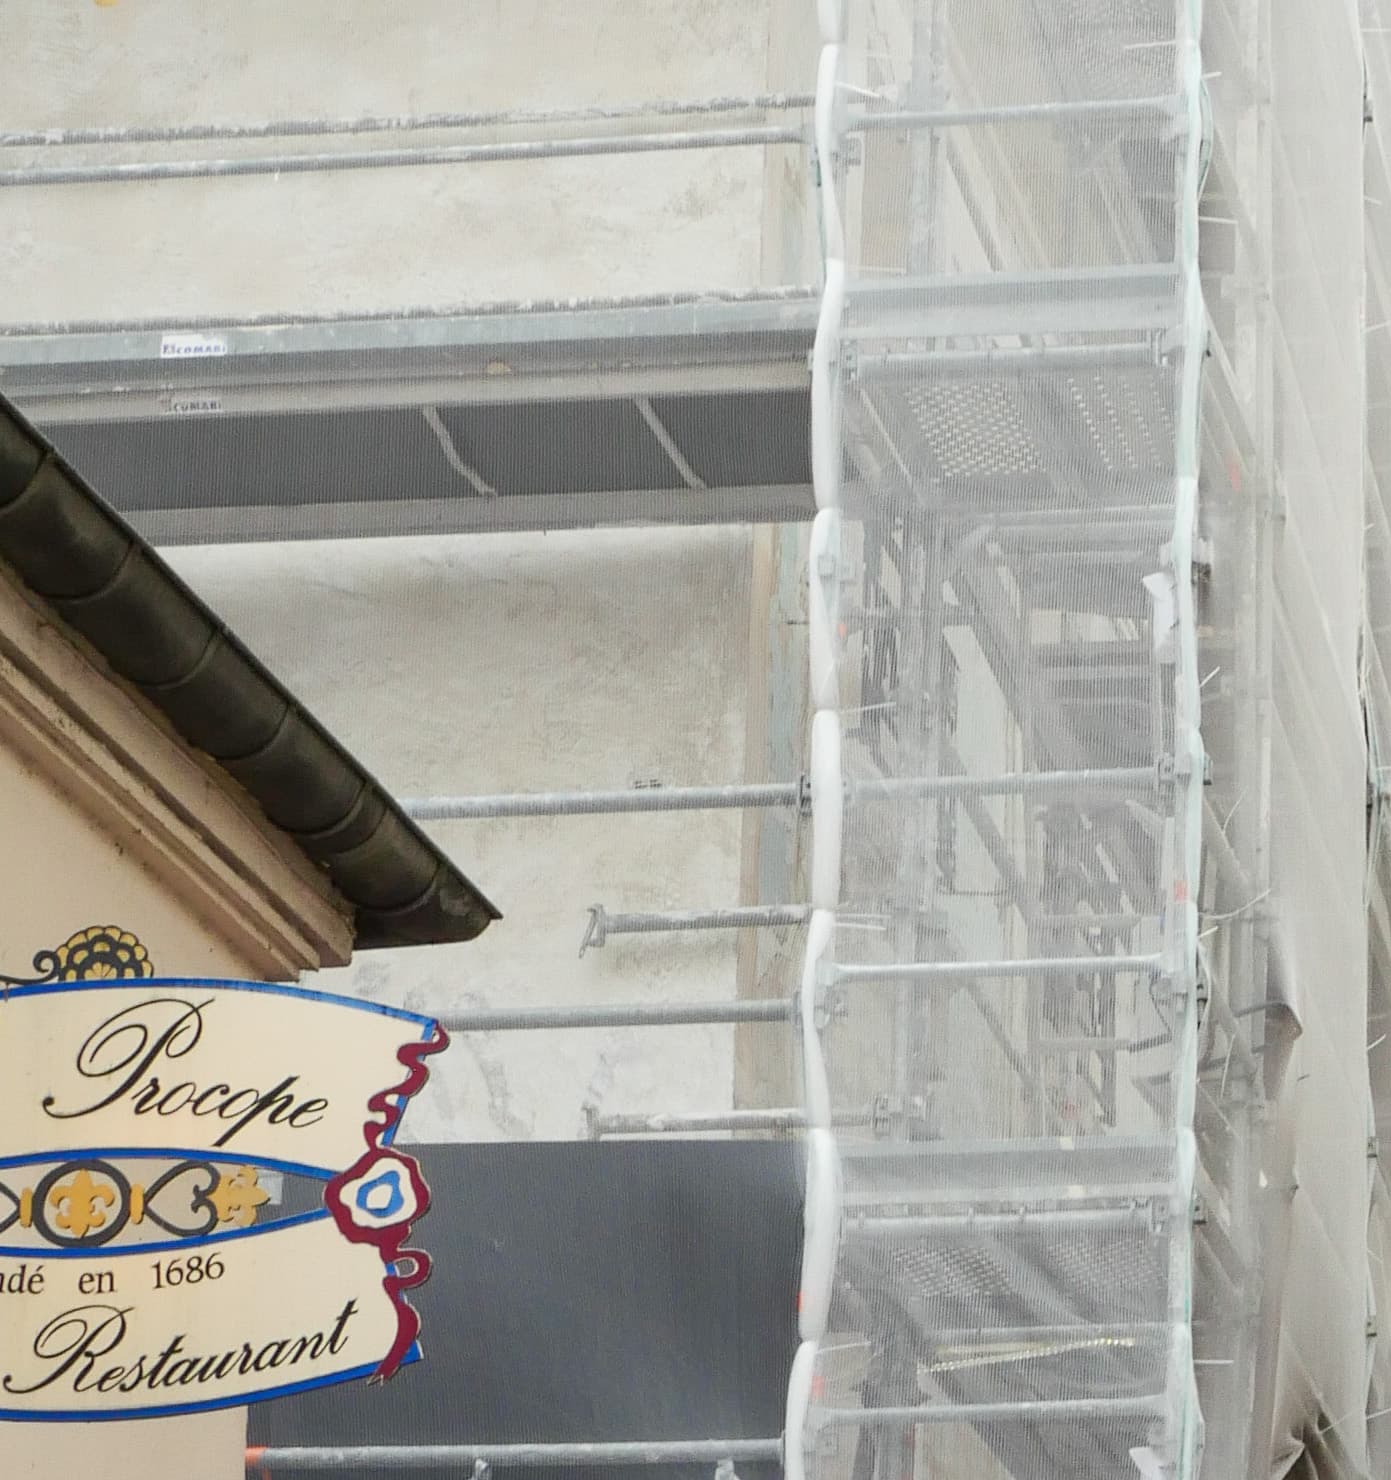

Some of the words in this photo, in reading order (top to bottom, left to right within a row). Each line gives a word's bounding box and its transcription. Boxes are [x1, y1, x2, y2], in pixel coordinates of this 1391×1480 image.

[42, 997, 329, 1147] Procope
[78, 1271, 118, 1295] en
[152, 1252, 226, 1290] 1686
[2, 1298, 359, 1395] Restaurant
